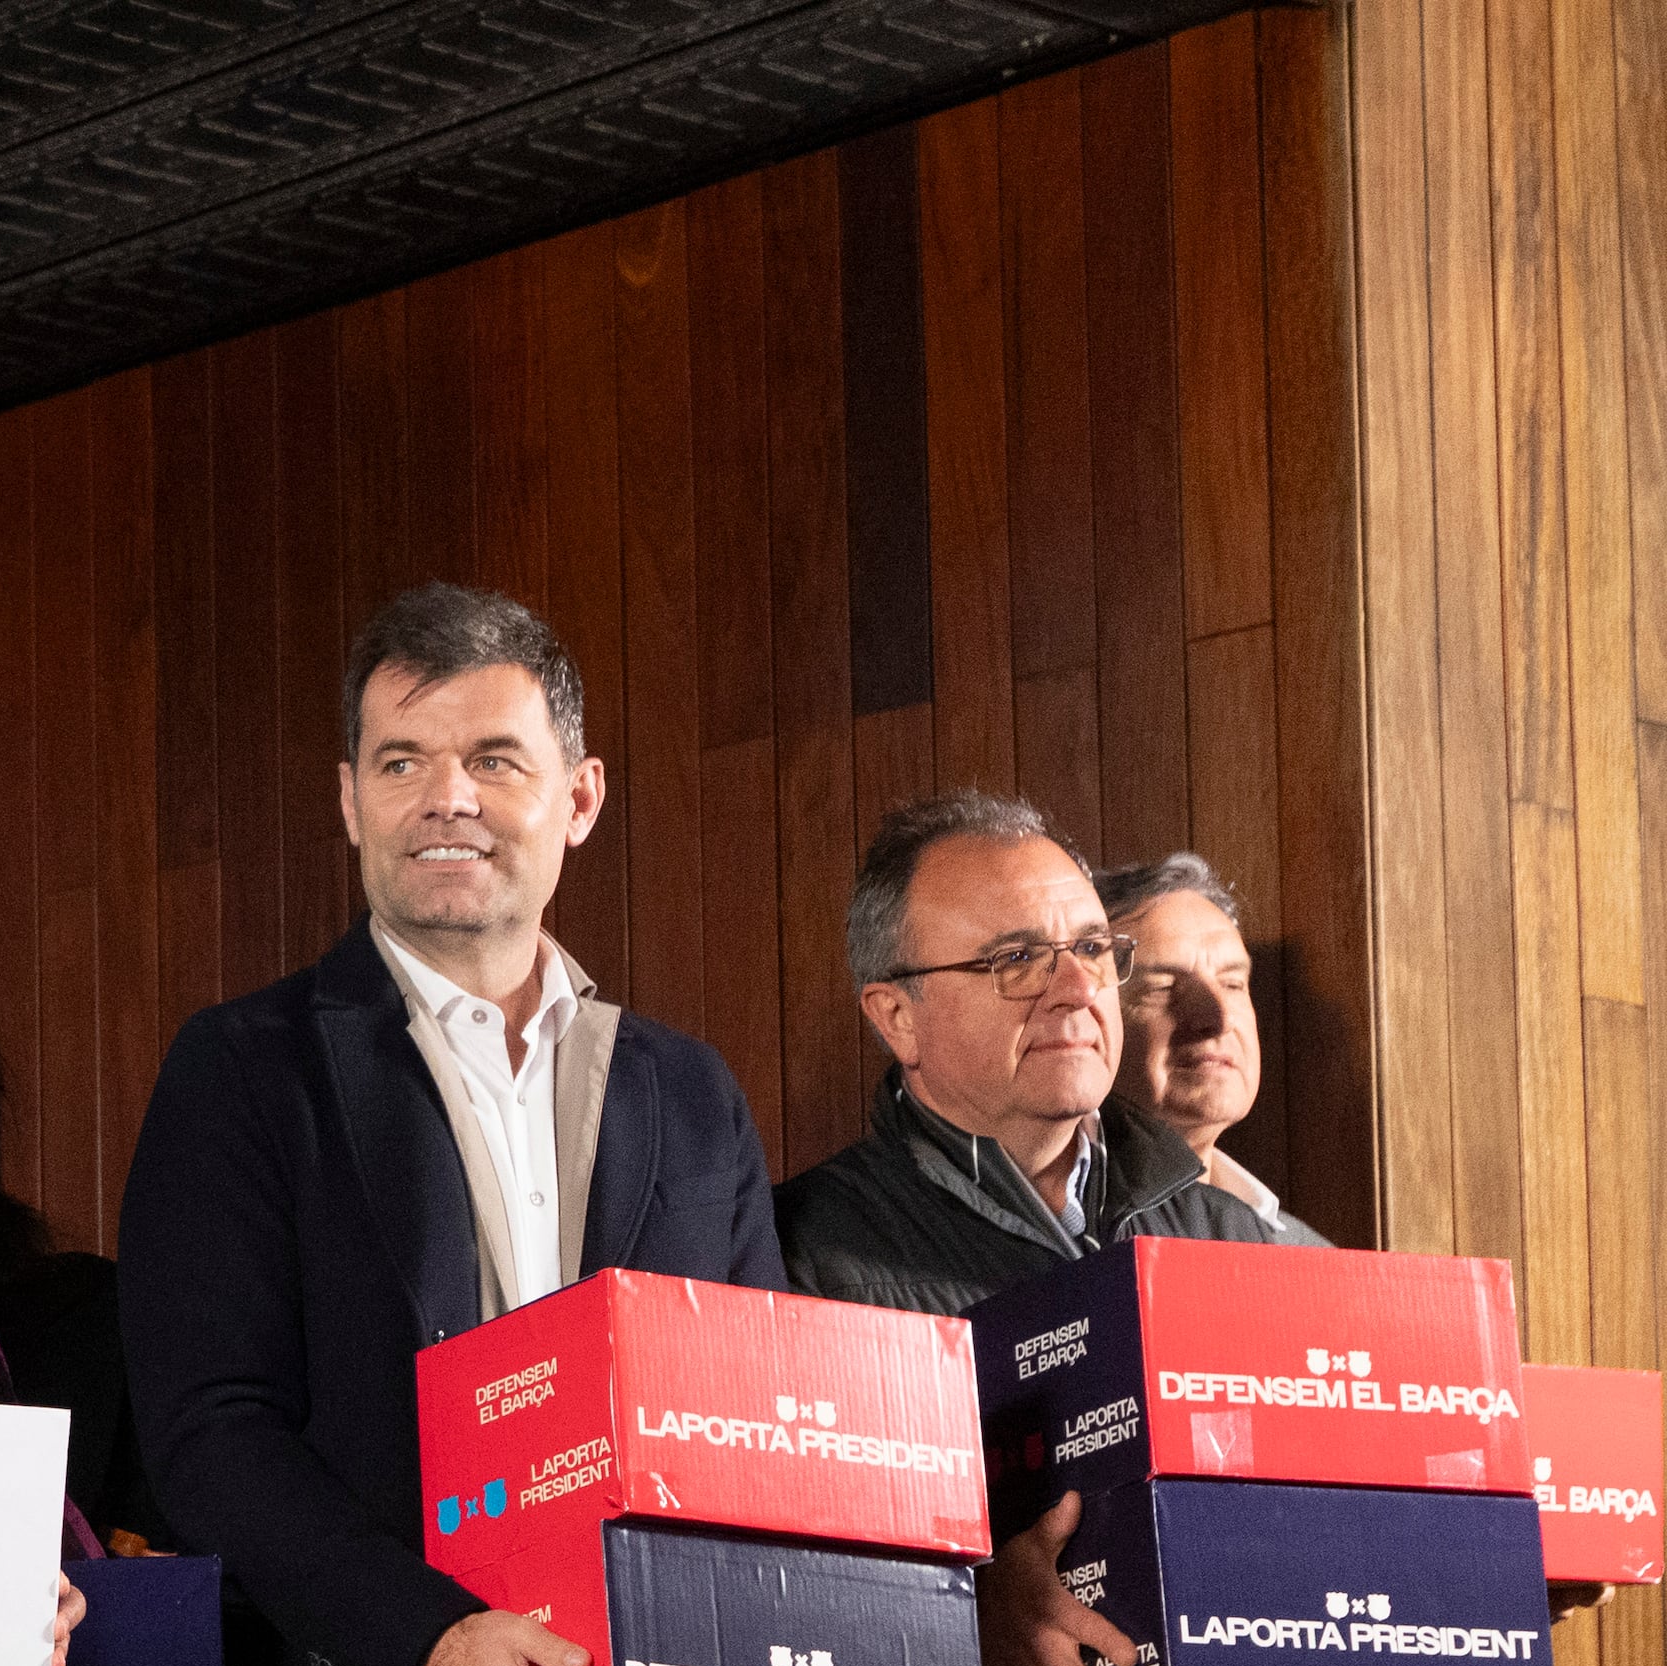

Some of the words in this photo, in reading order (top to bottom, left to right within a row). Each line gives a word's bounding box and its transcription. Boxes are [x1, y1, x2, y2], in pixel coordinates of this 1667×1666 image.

[1014, 1317, 1090, 1362] DEFENSEM
[1018, 1359, 1037, 1380] EL
[1037, 1339, 1088, 1373] BARÇA
[475, 1357, 558, 1406] DEFENSEM
[479, 1404, 500, 1425] EL
[500, 1380, 556, 1417] BARÇA
[1158, 1370, 1348, 1409] DEFENSEM
[1350, 1380, 1396, 1412] EL
[1399, 1383, 1520, 1425] BARÇA
[1055, 1416, 1140, 1464] PRESIDENT
[1065, 1396, 1140, 1439] LAPORTA
[530, 1436, 612, 1483] LAPORTA
[637, 1406, 796, 1455] LAPORTA
[798, 1427, 975, 1478] PRESIDENT
[520, 1457, 613, 1510] PRESIDENT
[1534, 1484, 1566, 1512] EL
[1569, 1486, 1657, 1523] BARÇA
[1060, 1559, 1107, 1588] ENSEM
[1075, 1582, 1106, 1608] RÇA
[1179, 1614, 1348, 1651] LAPORTA
[1349, 1622, 1539, 1660] PRESIDENT
